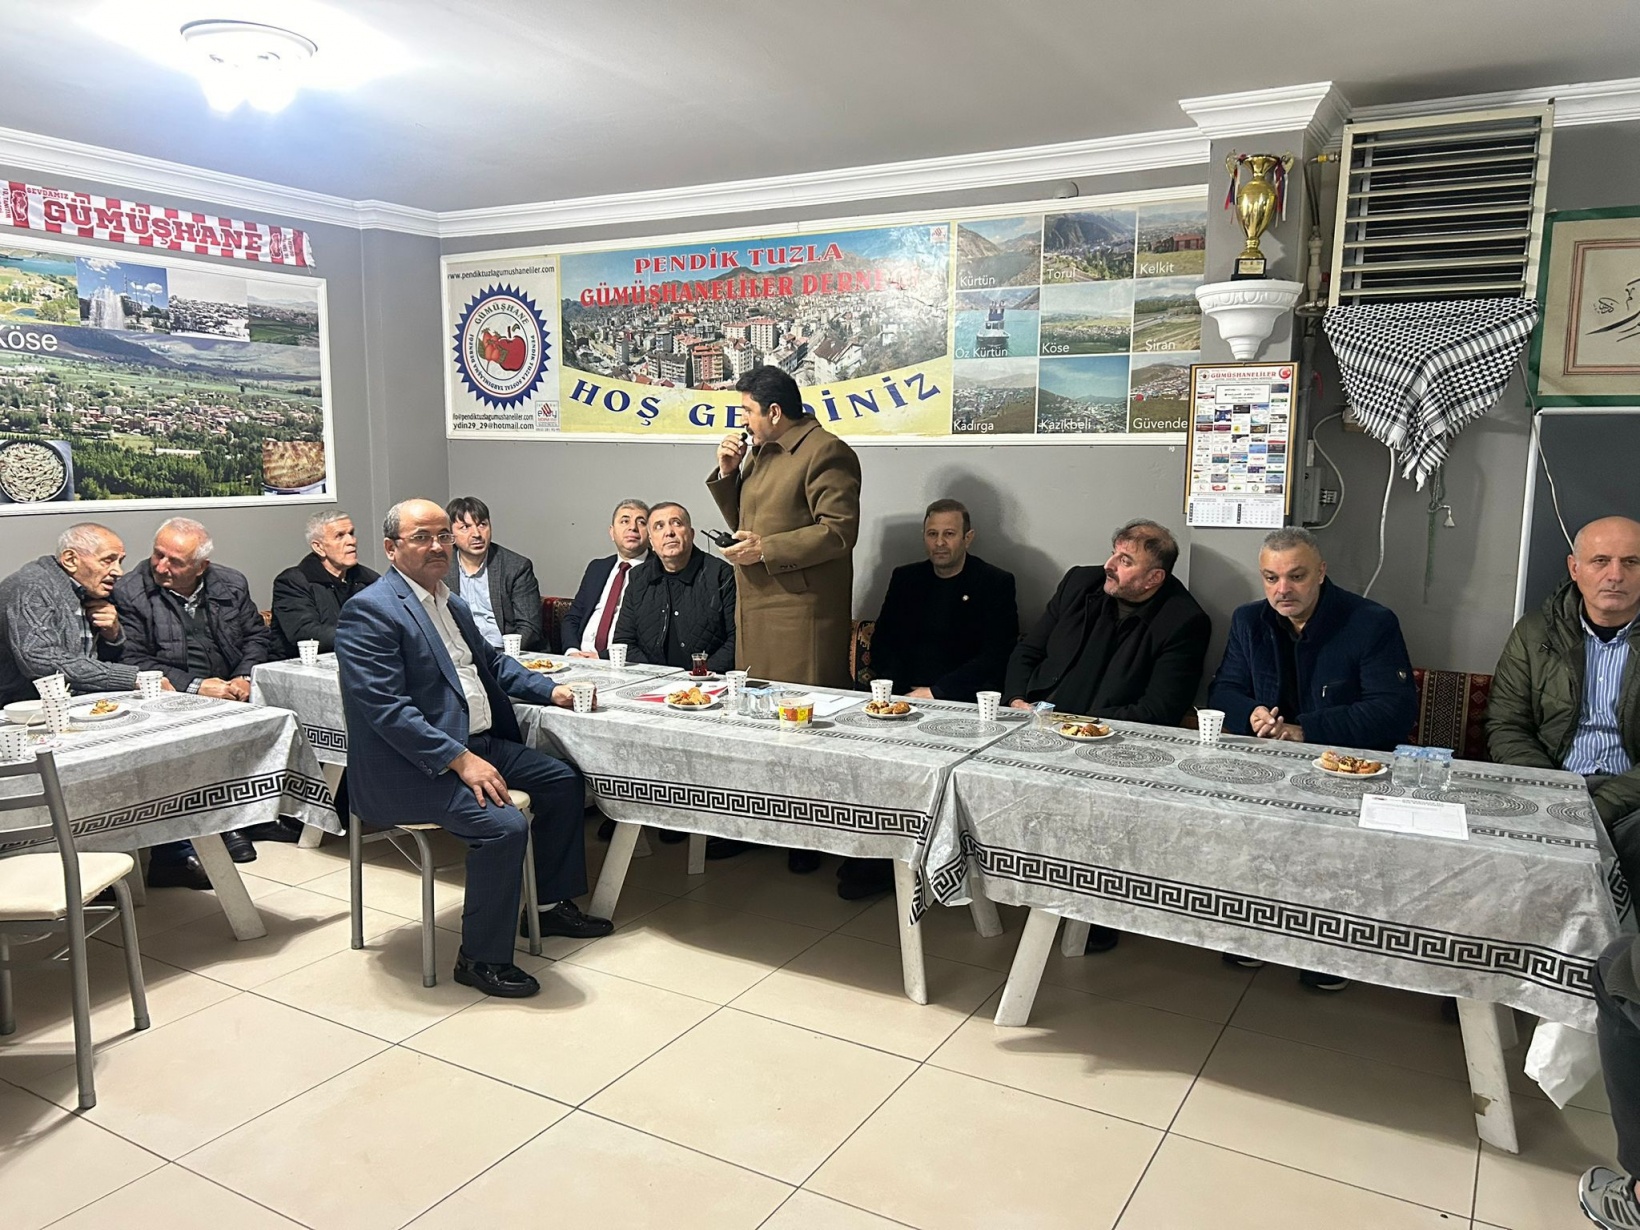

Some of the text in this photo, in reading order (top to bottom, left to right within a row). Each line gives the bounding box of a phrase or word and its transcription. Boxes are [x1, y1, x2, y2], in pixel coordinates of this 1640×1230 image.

[26, 187, 69, 199] SEVDAMIZ
[43, 197, 263, 253] GÜMÜŞHANE
[634, 242, 843, 275] PENDİK TUZLA
[1046, 267, 1076, 280] Torul
[1139, 261, 1175, 275] Kelkit
[960, 274, 996, 287] Kürtün
[579, 273, 794, 311] GÜMÜŞHANELİLER
[475, 303, 530, 325] GÜMÜŞHANE
[973, 346, 1008, 358] Kürtün
[1042, 342, 1070, 354] Köse
[569, 378, 661, 426] HOŞ
[688, 371, 941, 429] GEİNİZ
[1132, 417, 1188, 430] Güvende
